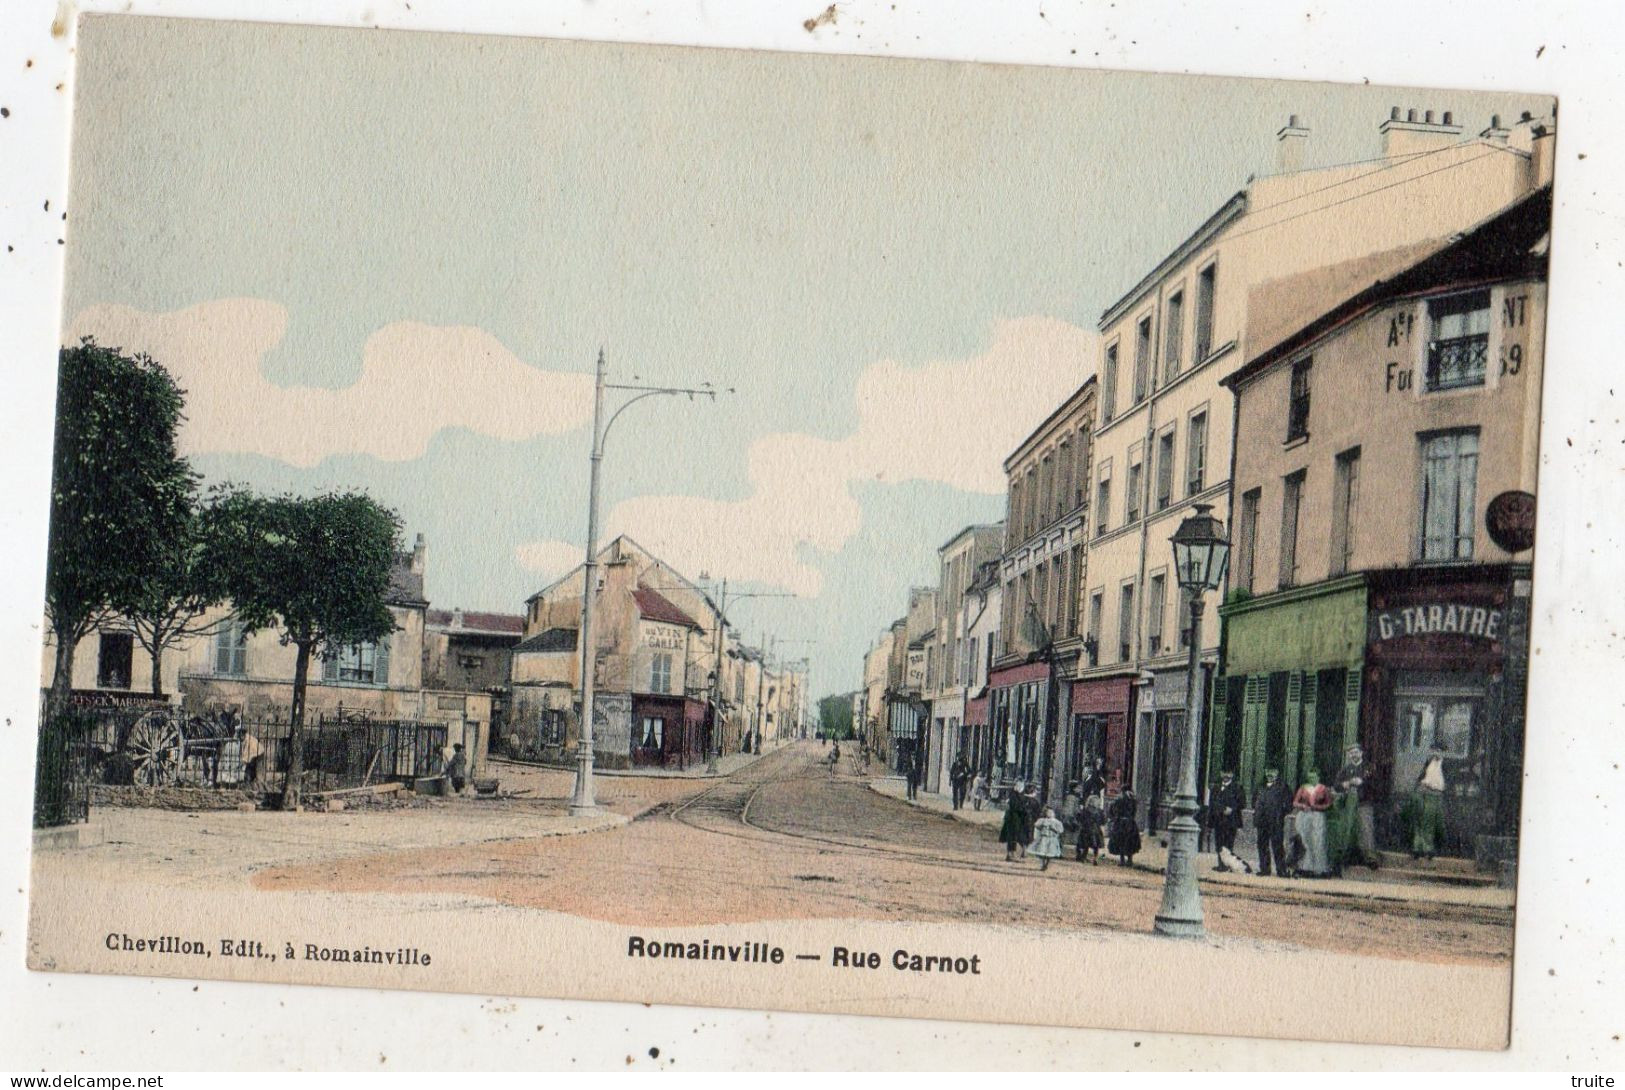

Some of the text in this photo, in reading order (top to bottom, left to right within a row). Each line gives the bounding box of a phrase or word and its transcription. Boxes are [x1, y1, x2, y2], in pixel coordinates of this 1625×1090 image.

[105, 933, 212, 957] Chevillon,
[285, 942, 296, 960] à
[305, 944, 431, 967] Romainville
[628, 936, 785, 964] Romainville
[832, 947, 881, 970] Rue
[892, 949, 981, 975] Carnot
